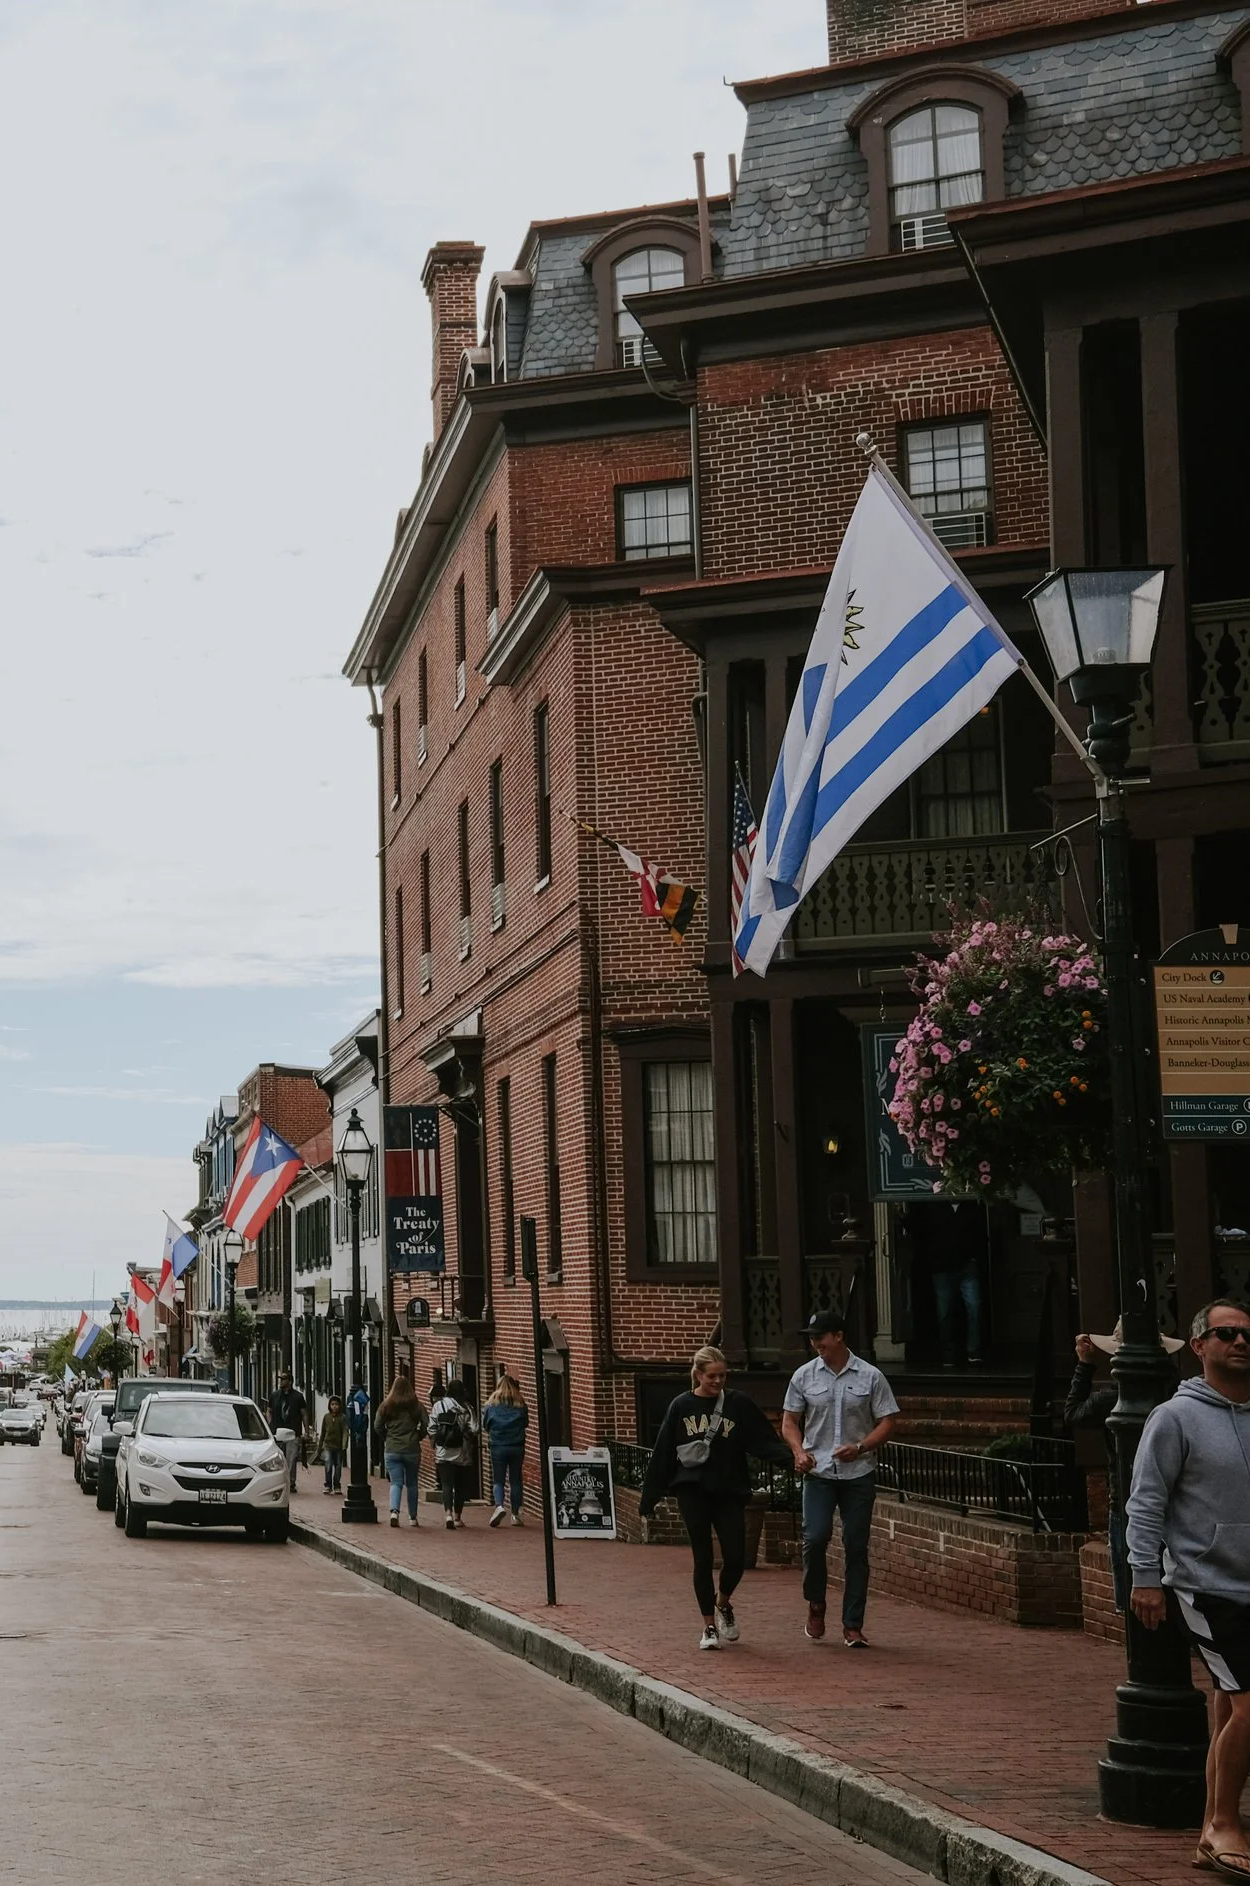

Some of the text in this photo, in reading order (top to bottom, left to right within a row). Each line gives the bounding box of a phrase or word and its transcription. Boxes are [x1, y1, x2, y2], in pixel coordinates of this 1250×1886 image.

[1161, 972, 1207, 984] City Dock
[1163, 993, 1246, 1006] US Naval Academy
[1164, 1015, 1200, 1025] Historic
[1201, 1015, 1246, 1028] Annapolis
[1166, 1036, 1210, 1050] Annapolis
[1211, 1036, 1241, 1047] Visitor
[1168, 1057, 1250, 1070] Banneker-Douglass
[1170, 1101, 1239, 1113] Hillman Garage
[1171, 1122, 1196, 1132] Gotts
[1197, 1122, 1229, 1135] Garage
[405, 1206, 427, 1217] The
[393, 1216, 440, 1231] Treaty
[409, 1231, 424, 1243] of
[395, 1240, 437, 1255] Paris
[683, 1414, 735, 1438] NAY
[561, 1480, 605, 1489] ANNAPOLIS
